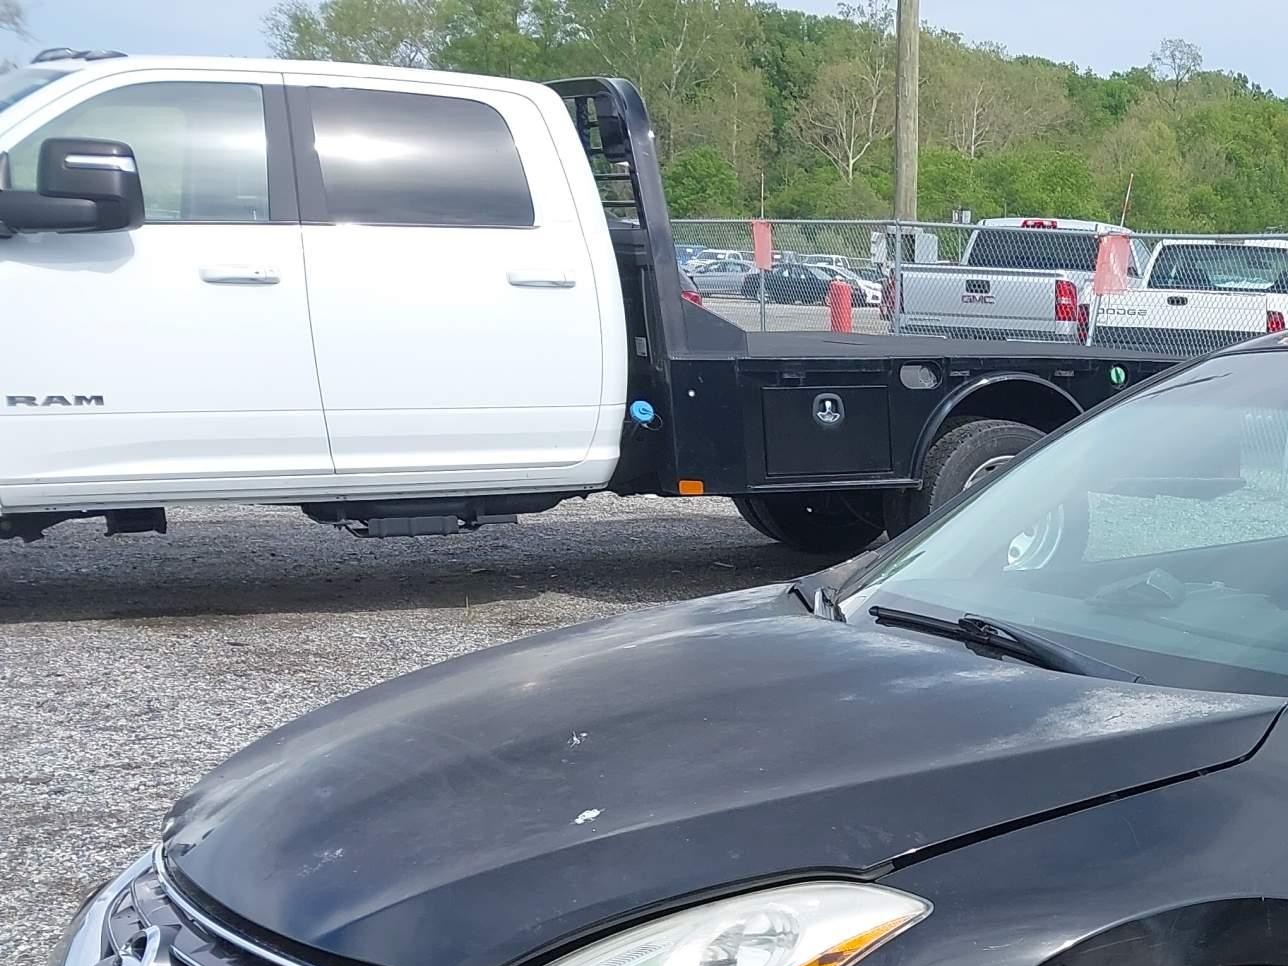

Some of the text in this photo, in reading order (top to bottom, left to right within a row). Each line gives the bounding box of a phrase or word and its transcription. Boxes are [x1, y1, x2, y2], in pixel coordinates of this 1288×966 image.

[961, 295, 996, 304] GMC
[1096, 308, 1148, 317] DODGE
[5, 395, 105, 407] RAM
